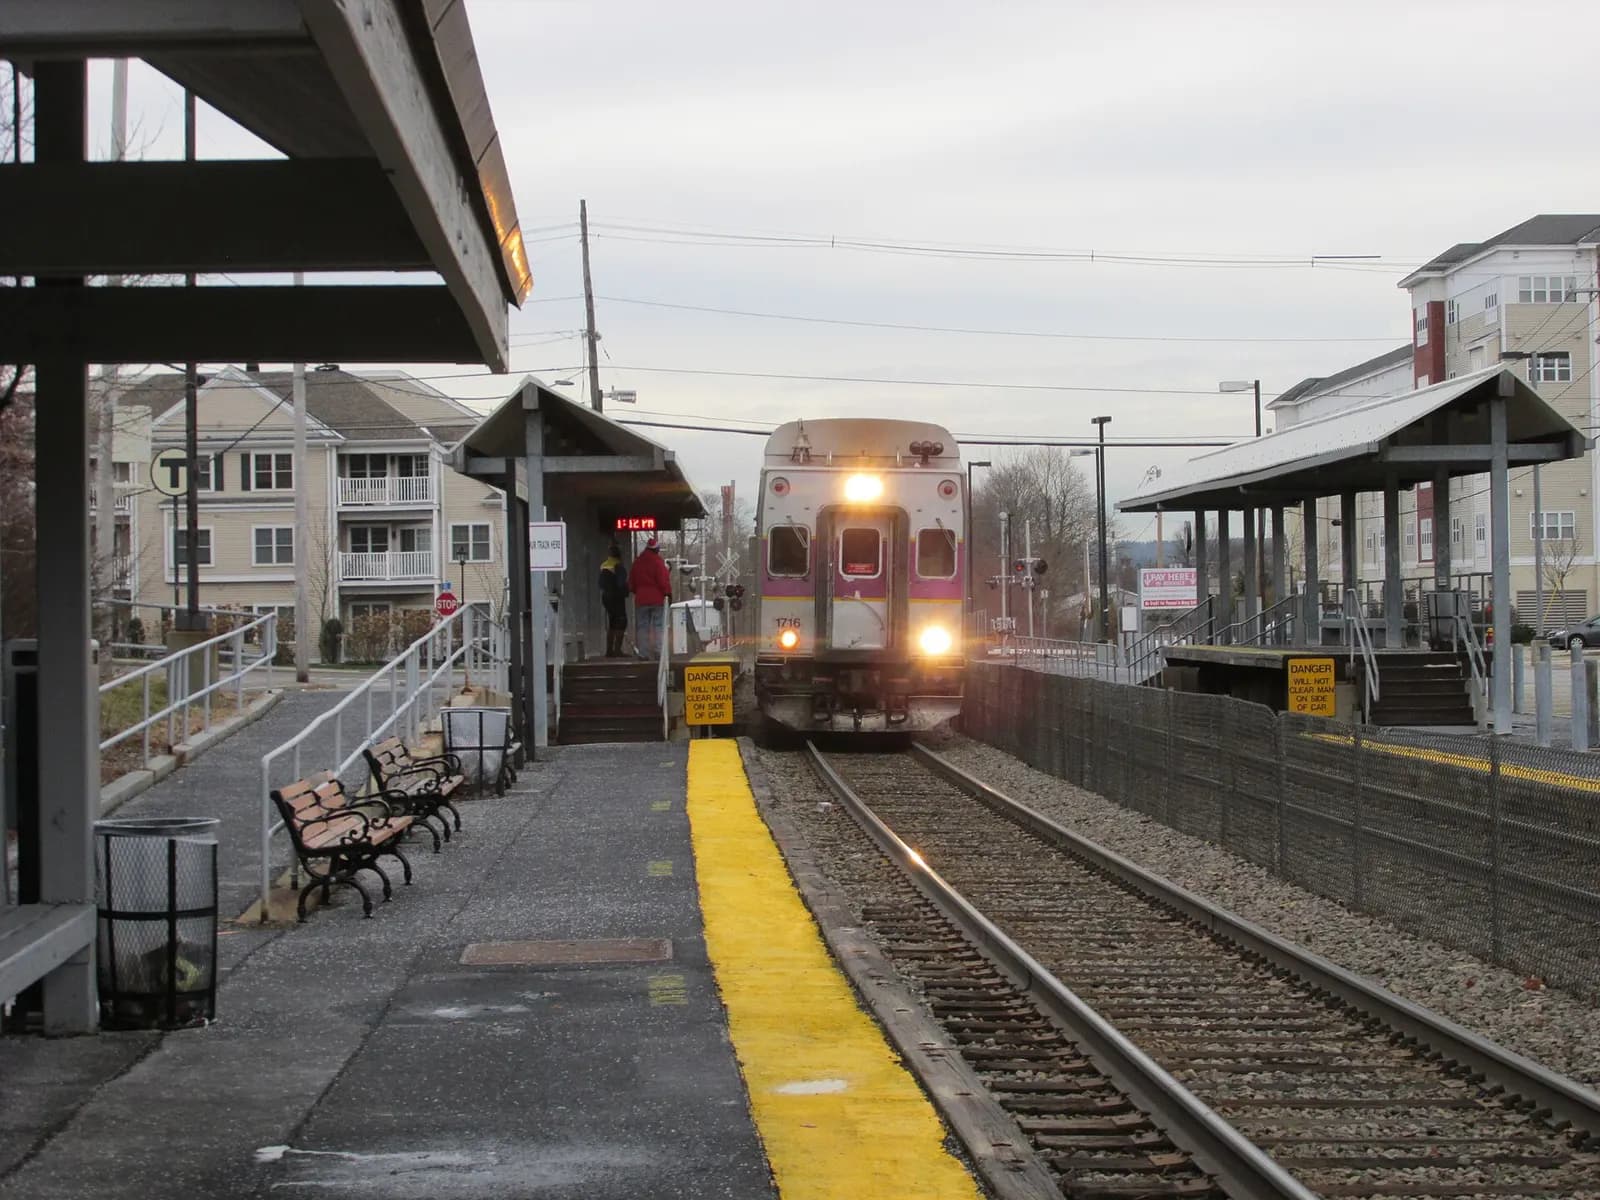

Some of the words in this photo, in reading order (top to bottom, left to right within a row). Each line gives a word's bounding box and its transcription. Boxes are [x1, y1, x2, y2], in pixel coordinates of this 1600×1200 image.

[160, 458, 188, 488] T
[617, 519, 639, 529] 1:12
[642, 519, 655, 529] PM
[1151, 572, 1165, 580] PAY
[1168, 572, 1188, 580] HERE
[437, 600, 457, 610] STOP
[776, 618, 800, 628] 1716
[1291, 664, 1332, 673] DANGER
[688, 672, 729, 681] DANGER
[708, 711, 724, 719] CAR
